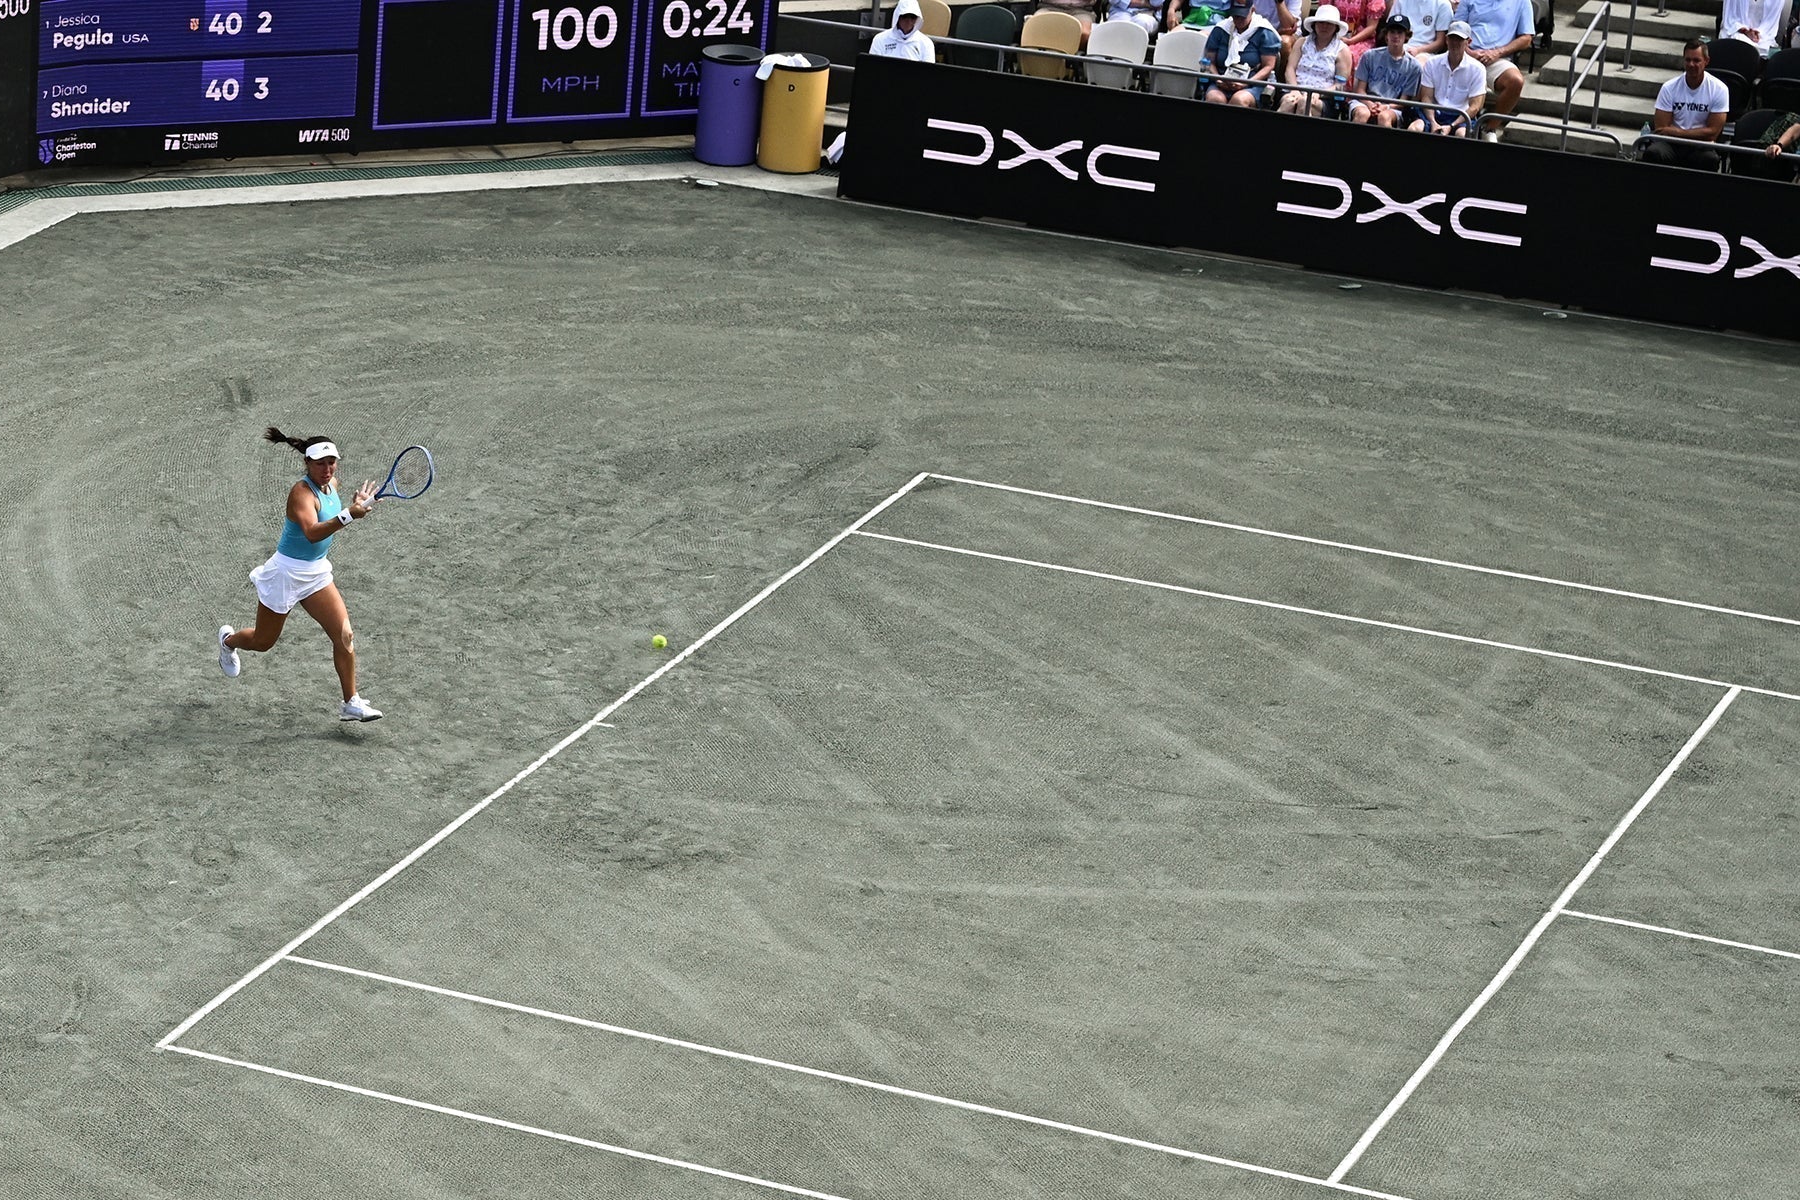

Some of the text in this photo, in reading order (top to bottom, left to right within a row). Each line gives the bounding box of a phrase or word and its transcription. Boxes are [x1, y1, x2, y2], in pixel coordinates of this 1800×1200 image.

[54, 13, 100, 28] Jessica
[208, 11, 272, 35] 40 2
[662, 0, 754, 38] 0:24
[531, 5, 618, 51] 100
[53, 28, 150, 50] Pegula USA
[205, 77, 269, 101] 40 3
[542, 75, 600, 93] MPH
[733, 78, 741, 87] C
[788, 84, 796, 92] D
[52, 84, 88, 98] Diana
[51, 98, 131, 118] Shnaider
[1686, 102, 1709, 113] YONEX
[181, 132, 219, 141] TENNIS
[298, 128, 350, 143] WTA 500
[55, 142, 97, 152] Charleston
[181, 141, 218, 150] Channel
[55, 152, 76, 161] Open
[922, 118, 1161, 193] DXC
[1276, 170, 1528, 248] DXC
